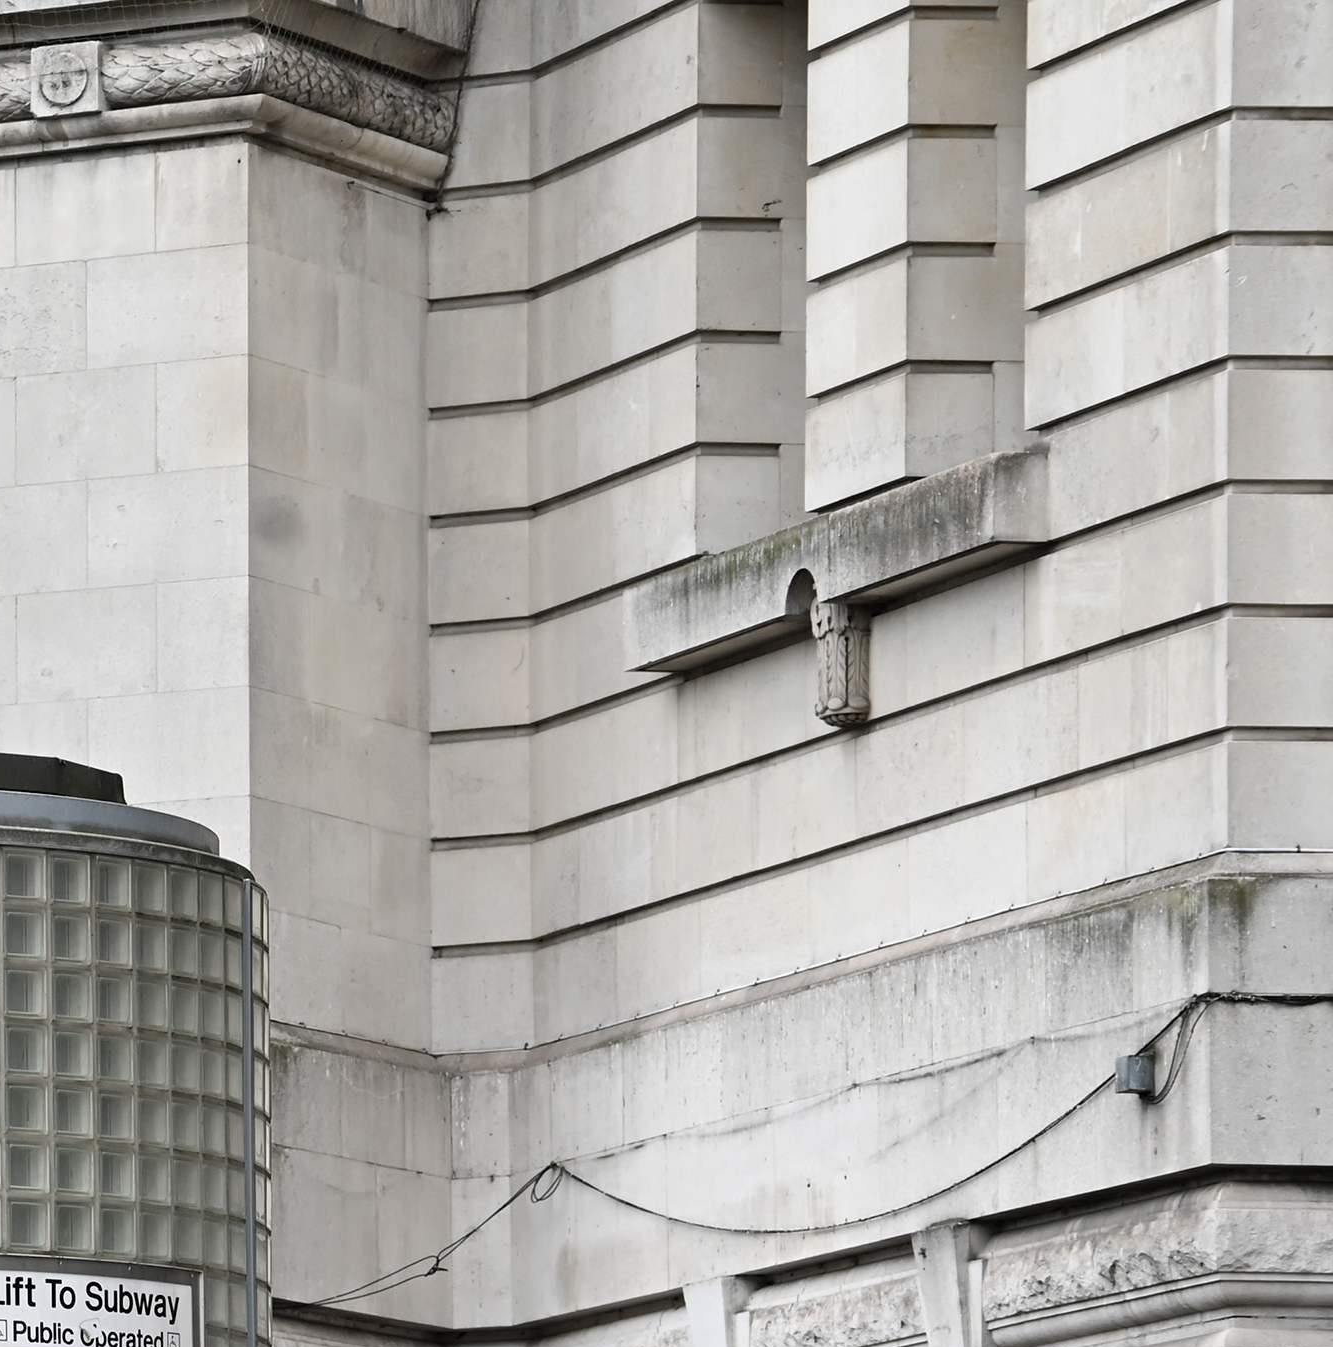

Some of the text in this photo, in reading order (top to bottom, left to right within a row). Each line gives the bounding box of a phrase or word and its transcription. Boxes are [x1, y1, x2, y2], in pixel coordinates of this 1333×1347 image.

[45, 1278, 76, 1310] To
[85, 1281, 180, 1325] Subway
[12, 1320, 75, 1345] Public
